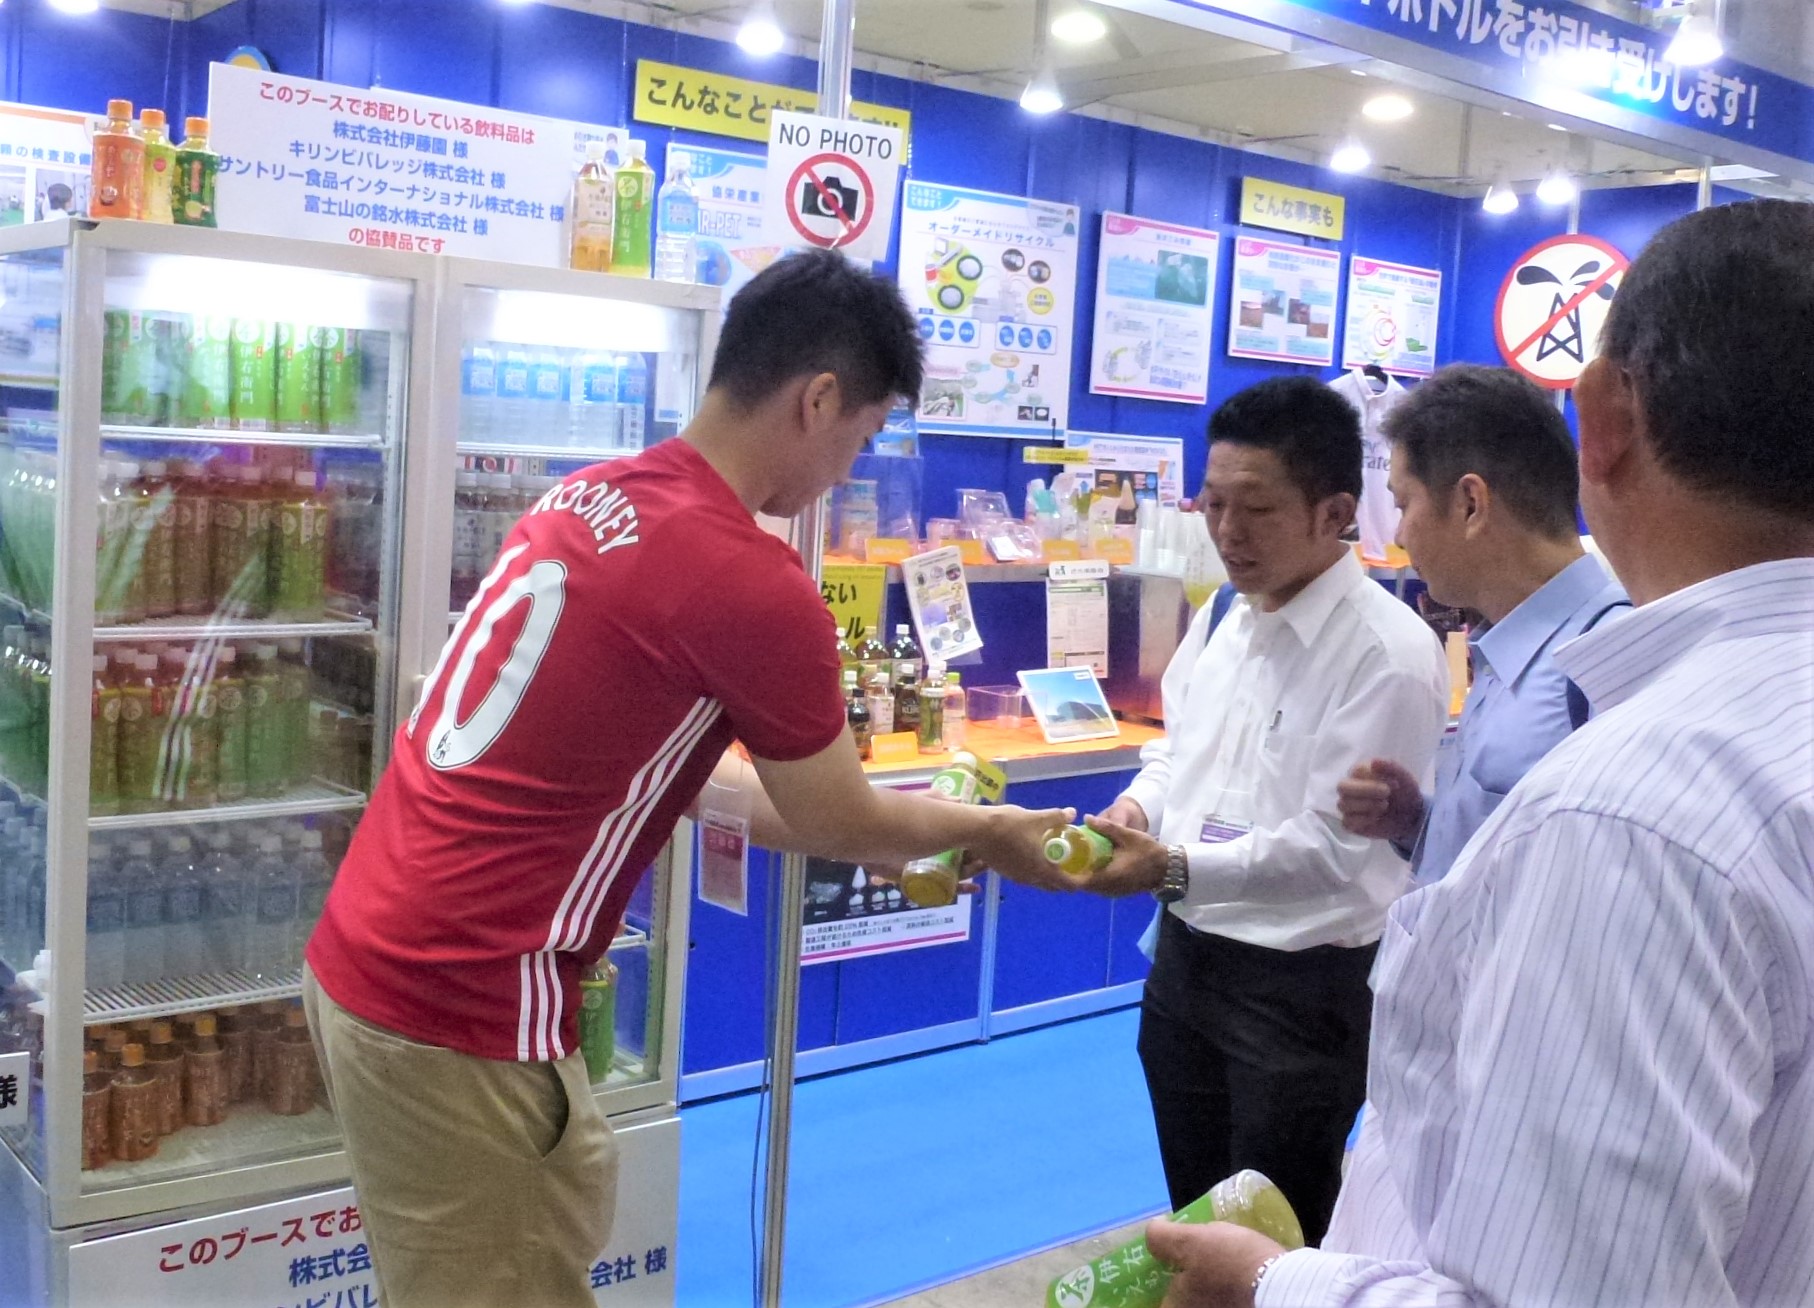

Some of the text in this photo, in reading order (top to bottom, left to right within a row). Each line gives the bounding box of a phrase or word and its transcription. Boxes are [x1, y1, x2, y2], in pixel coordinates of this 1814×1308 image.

[259, 81, 535, 145] このブースでお配りしている飲料品は
[332, 120, 469, 160] 株式会社伊藤園 様
[779, 122, 893, 161] NO PHOTO
[288, 139, 506, 190] キリンビバレッジ株式会社 様
[217, 154, 545, 221] サントリー食品インターナショナル株式会社
[549, 204, 565, 223] 様
[1252, 192, 1335, 228] こんな事実も
[304, 194, 489, 236] 富士山の銘水株式会社 様
[928, 220, 1056, 248] オーダーメイドリサイクル
[348, 226, 446, 254] の協賛品です
[530, 479, 640, 556] ROONEY
[287, 1242, 373, 1288] 株式会
[590, 1245, 667, 1290] 会社 様
